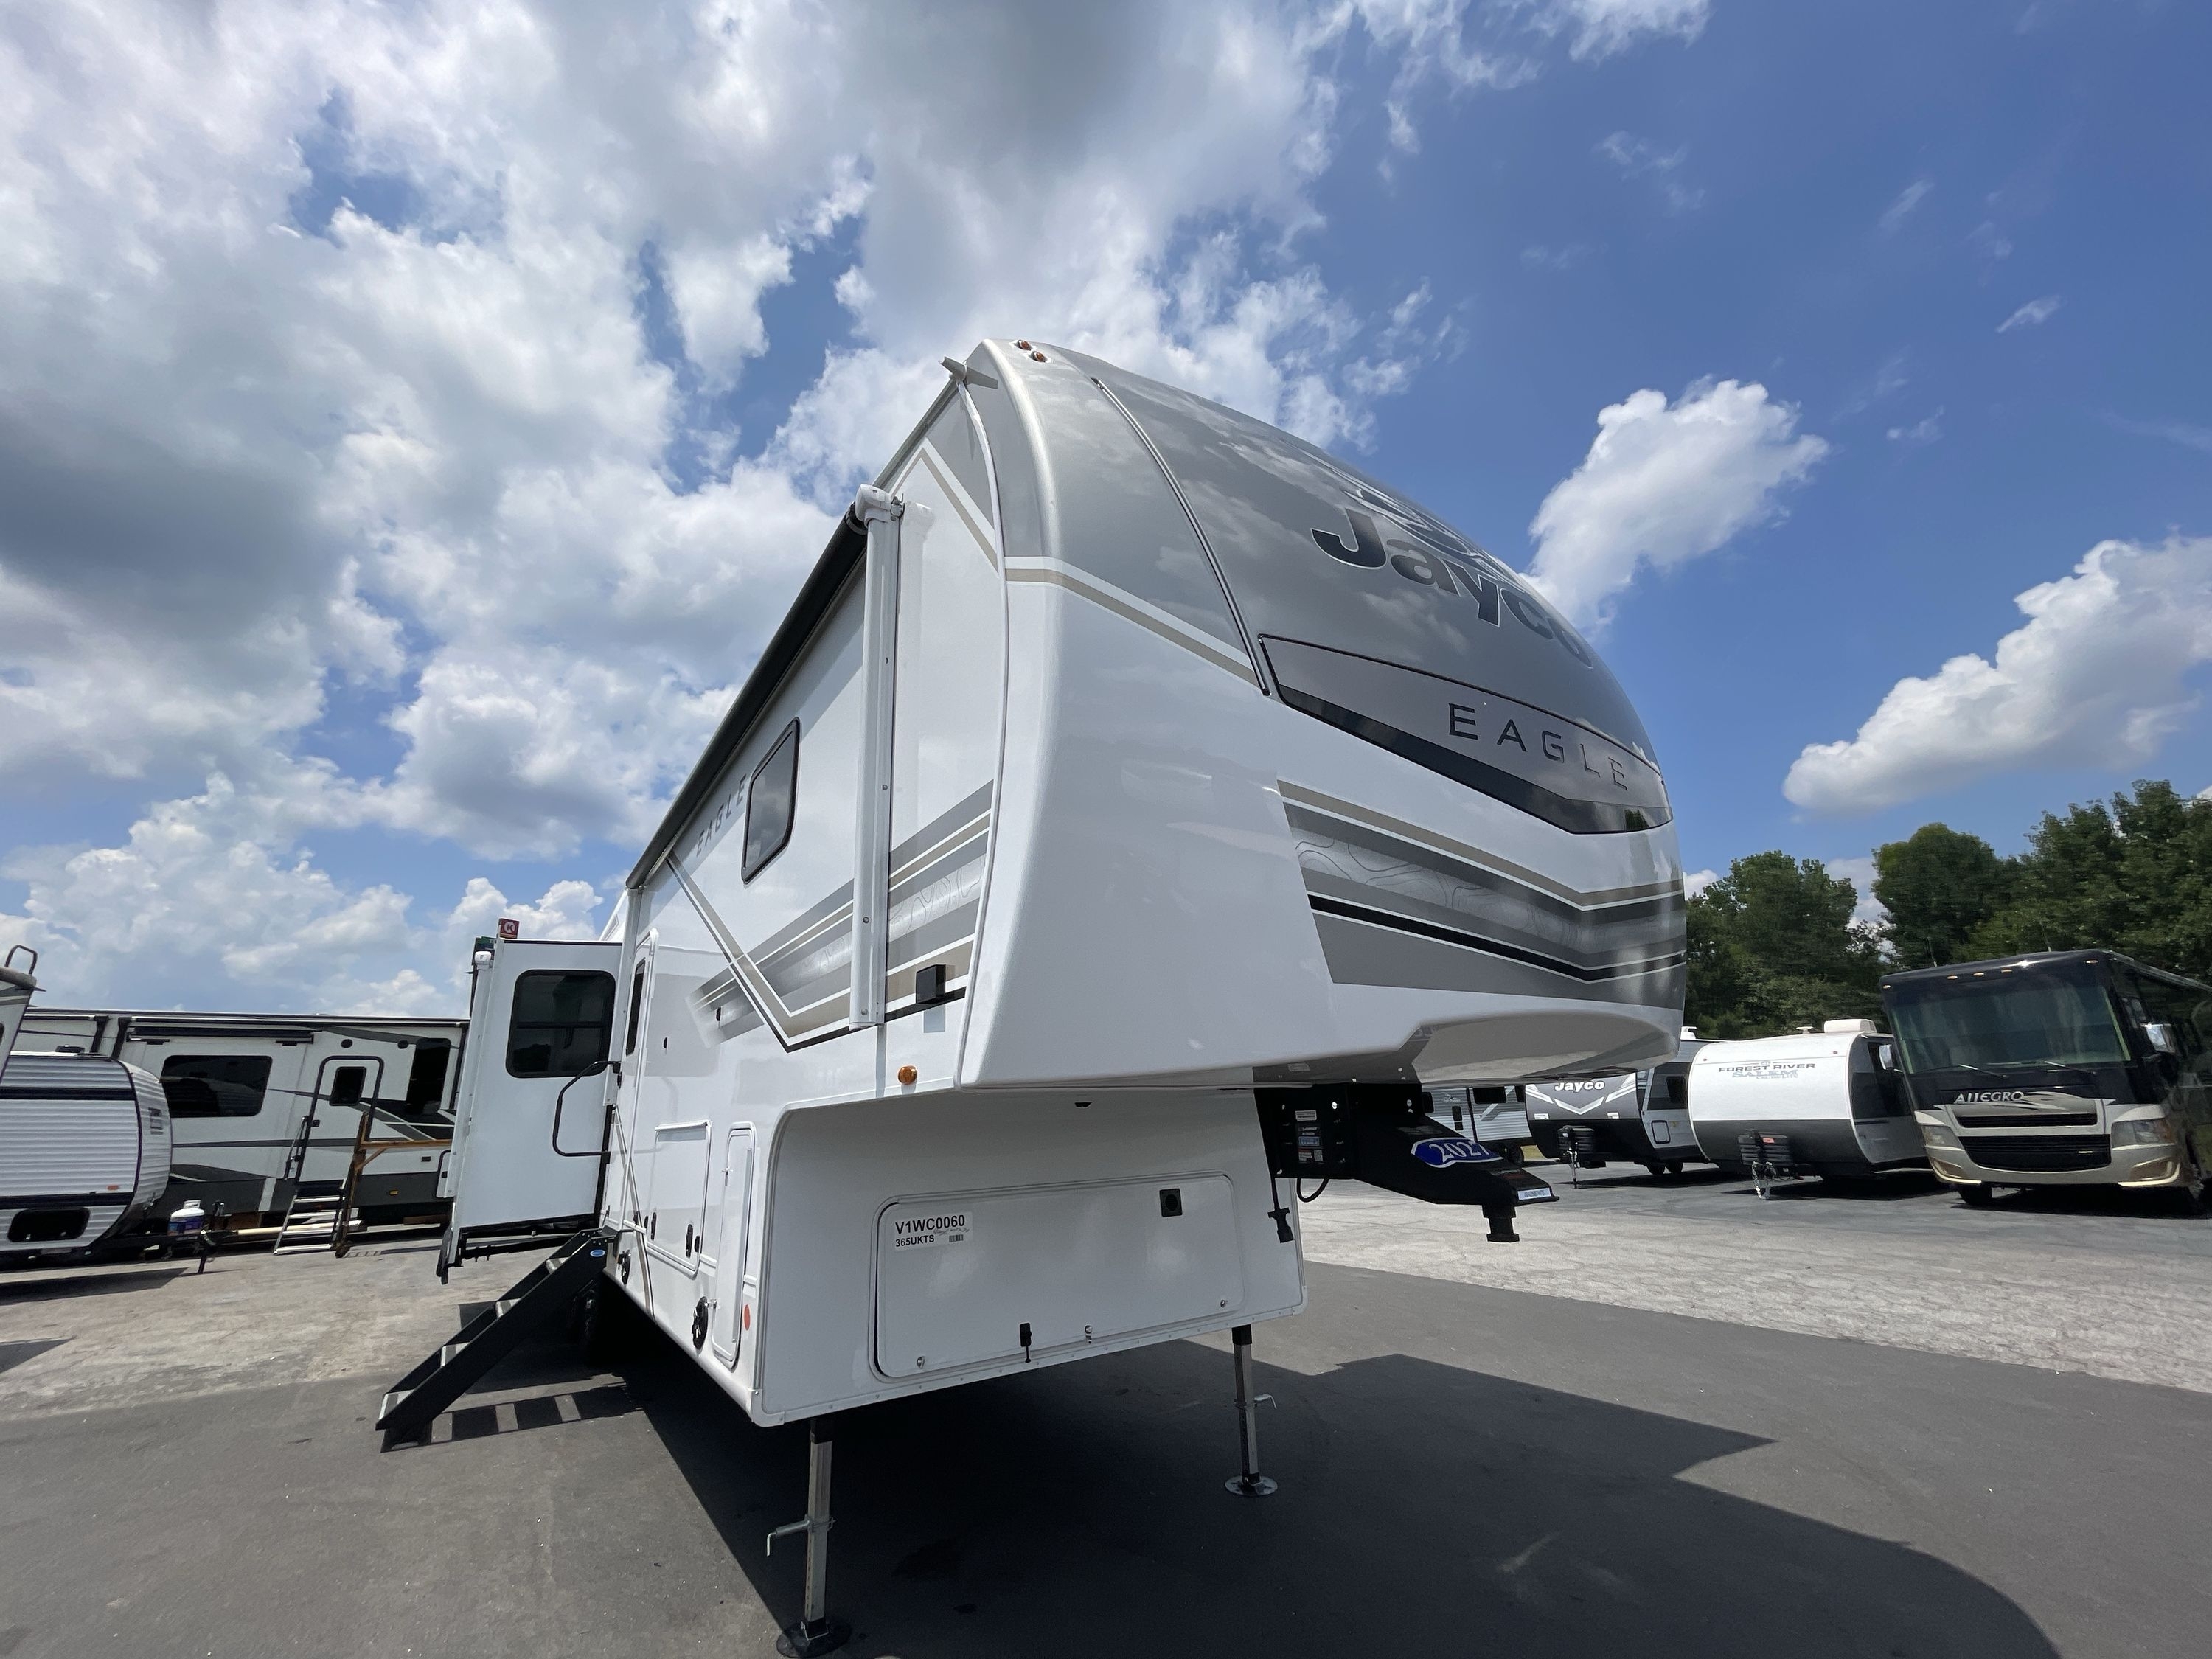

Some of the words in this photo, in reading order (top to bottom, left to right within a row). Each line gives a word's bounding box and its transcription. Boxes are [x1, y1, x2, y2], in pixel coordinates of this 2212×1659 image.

[1312, 507, 1593, 669] Jayco
[1449, 703, 1627, 790] EAGLE
[697, 773, 746, 857] EAGLE
[1732, 1070, 1799, 1078] SALEM
[1554, 1081, 1605, 1093] Jayco
[1953, 1091, 2024, 1105] ALLEGRO
[895, 1214, 965, 1234] V1WC0060
[895, 1234, 935, 1248] 365UKTS
